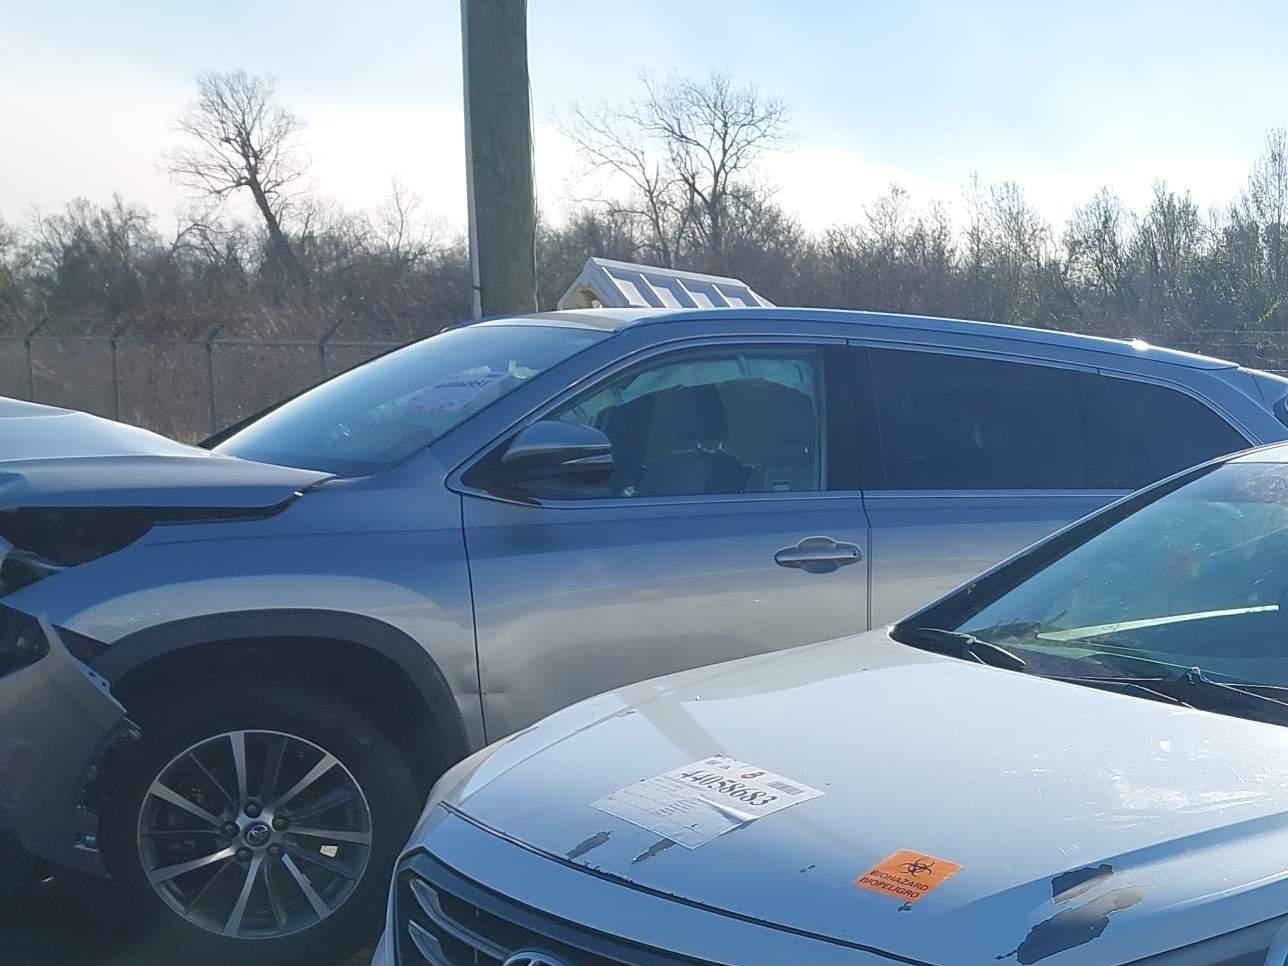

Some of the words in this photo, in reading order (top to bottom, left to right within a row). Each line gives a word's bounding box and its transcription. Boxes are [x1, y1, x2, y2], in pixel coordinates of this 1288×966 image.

[680, 769, 778, 806] 44058683
[860, 876, 921, 899] BIOPELIGRO
[869, 869, 929, 891] BIOHAZARD
